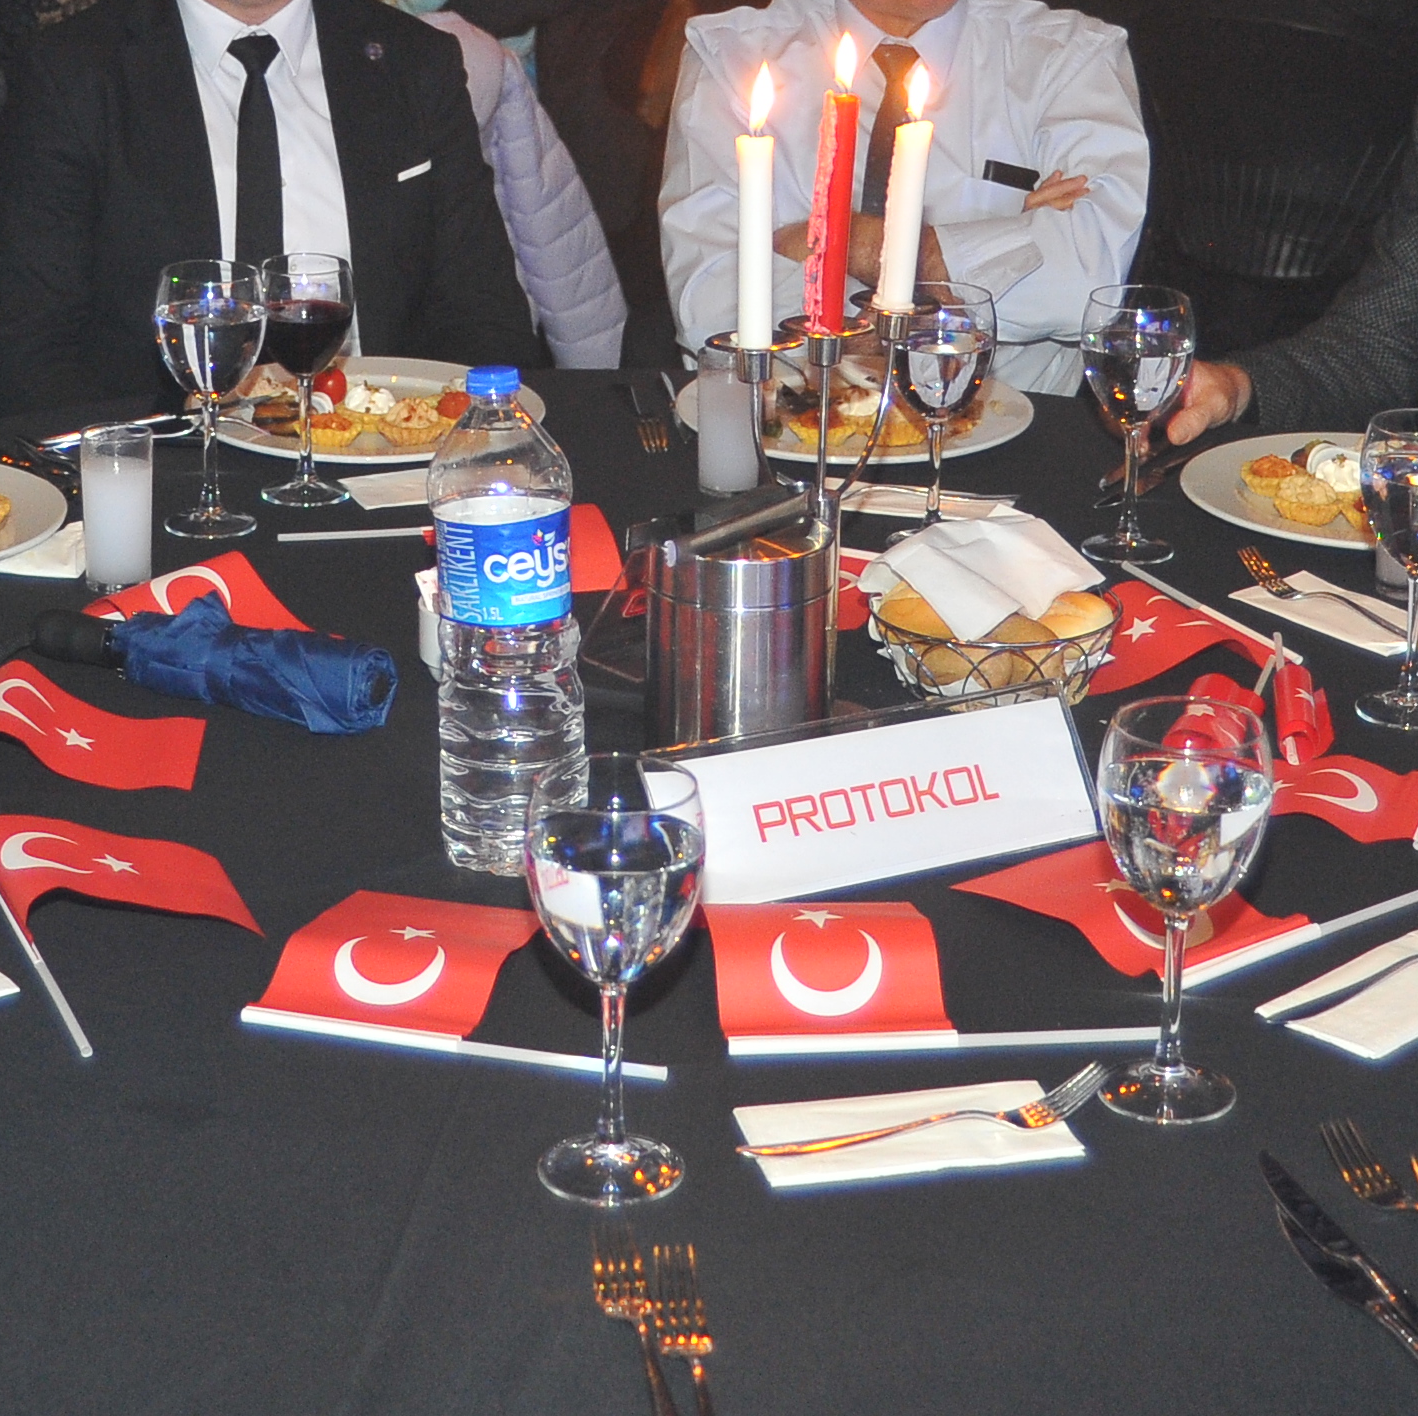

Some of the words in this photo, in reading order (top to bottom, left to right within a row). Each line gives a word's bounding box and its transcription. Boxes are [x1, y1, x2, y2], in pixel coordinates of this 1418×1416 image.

[444, 523, 483, 623] SAKLIKENT
[483, 537, 571, 588] ceys
[752, 764, 1000, 843] PROTOKOL
